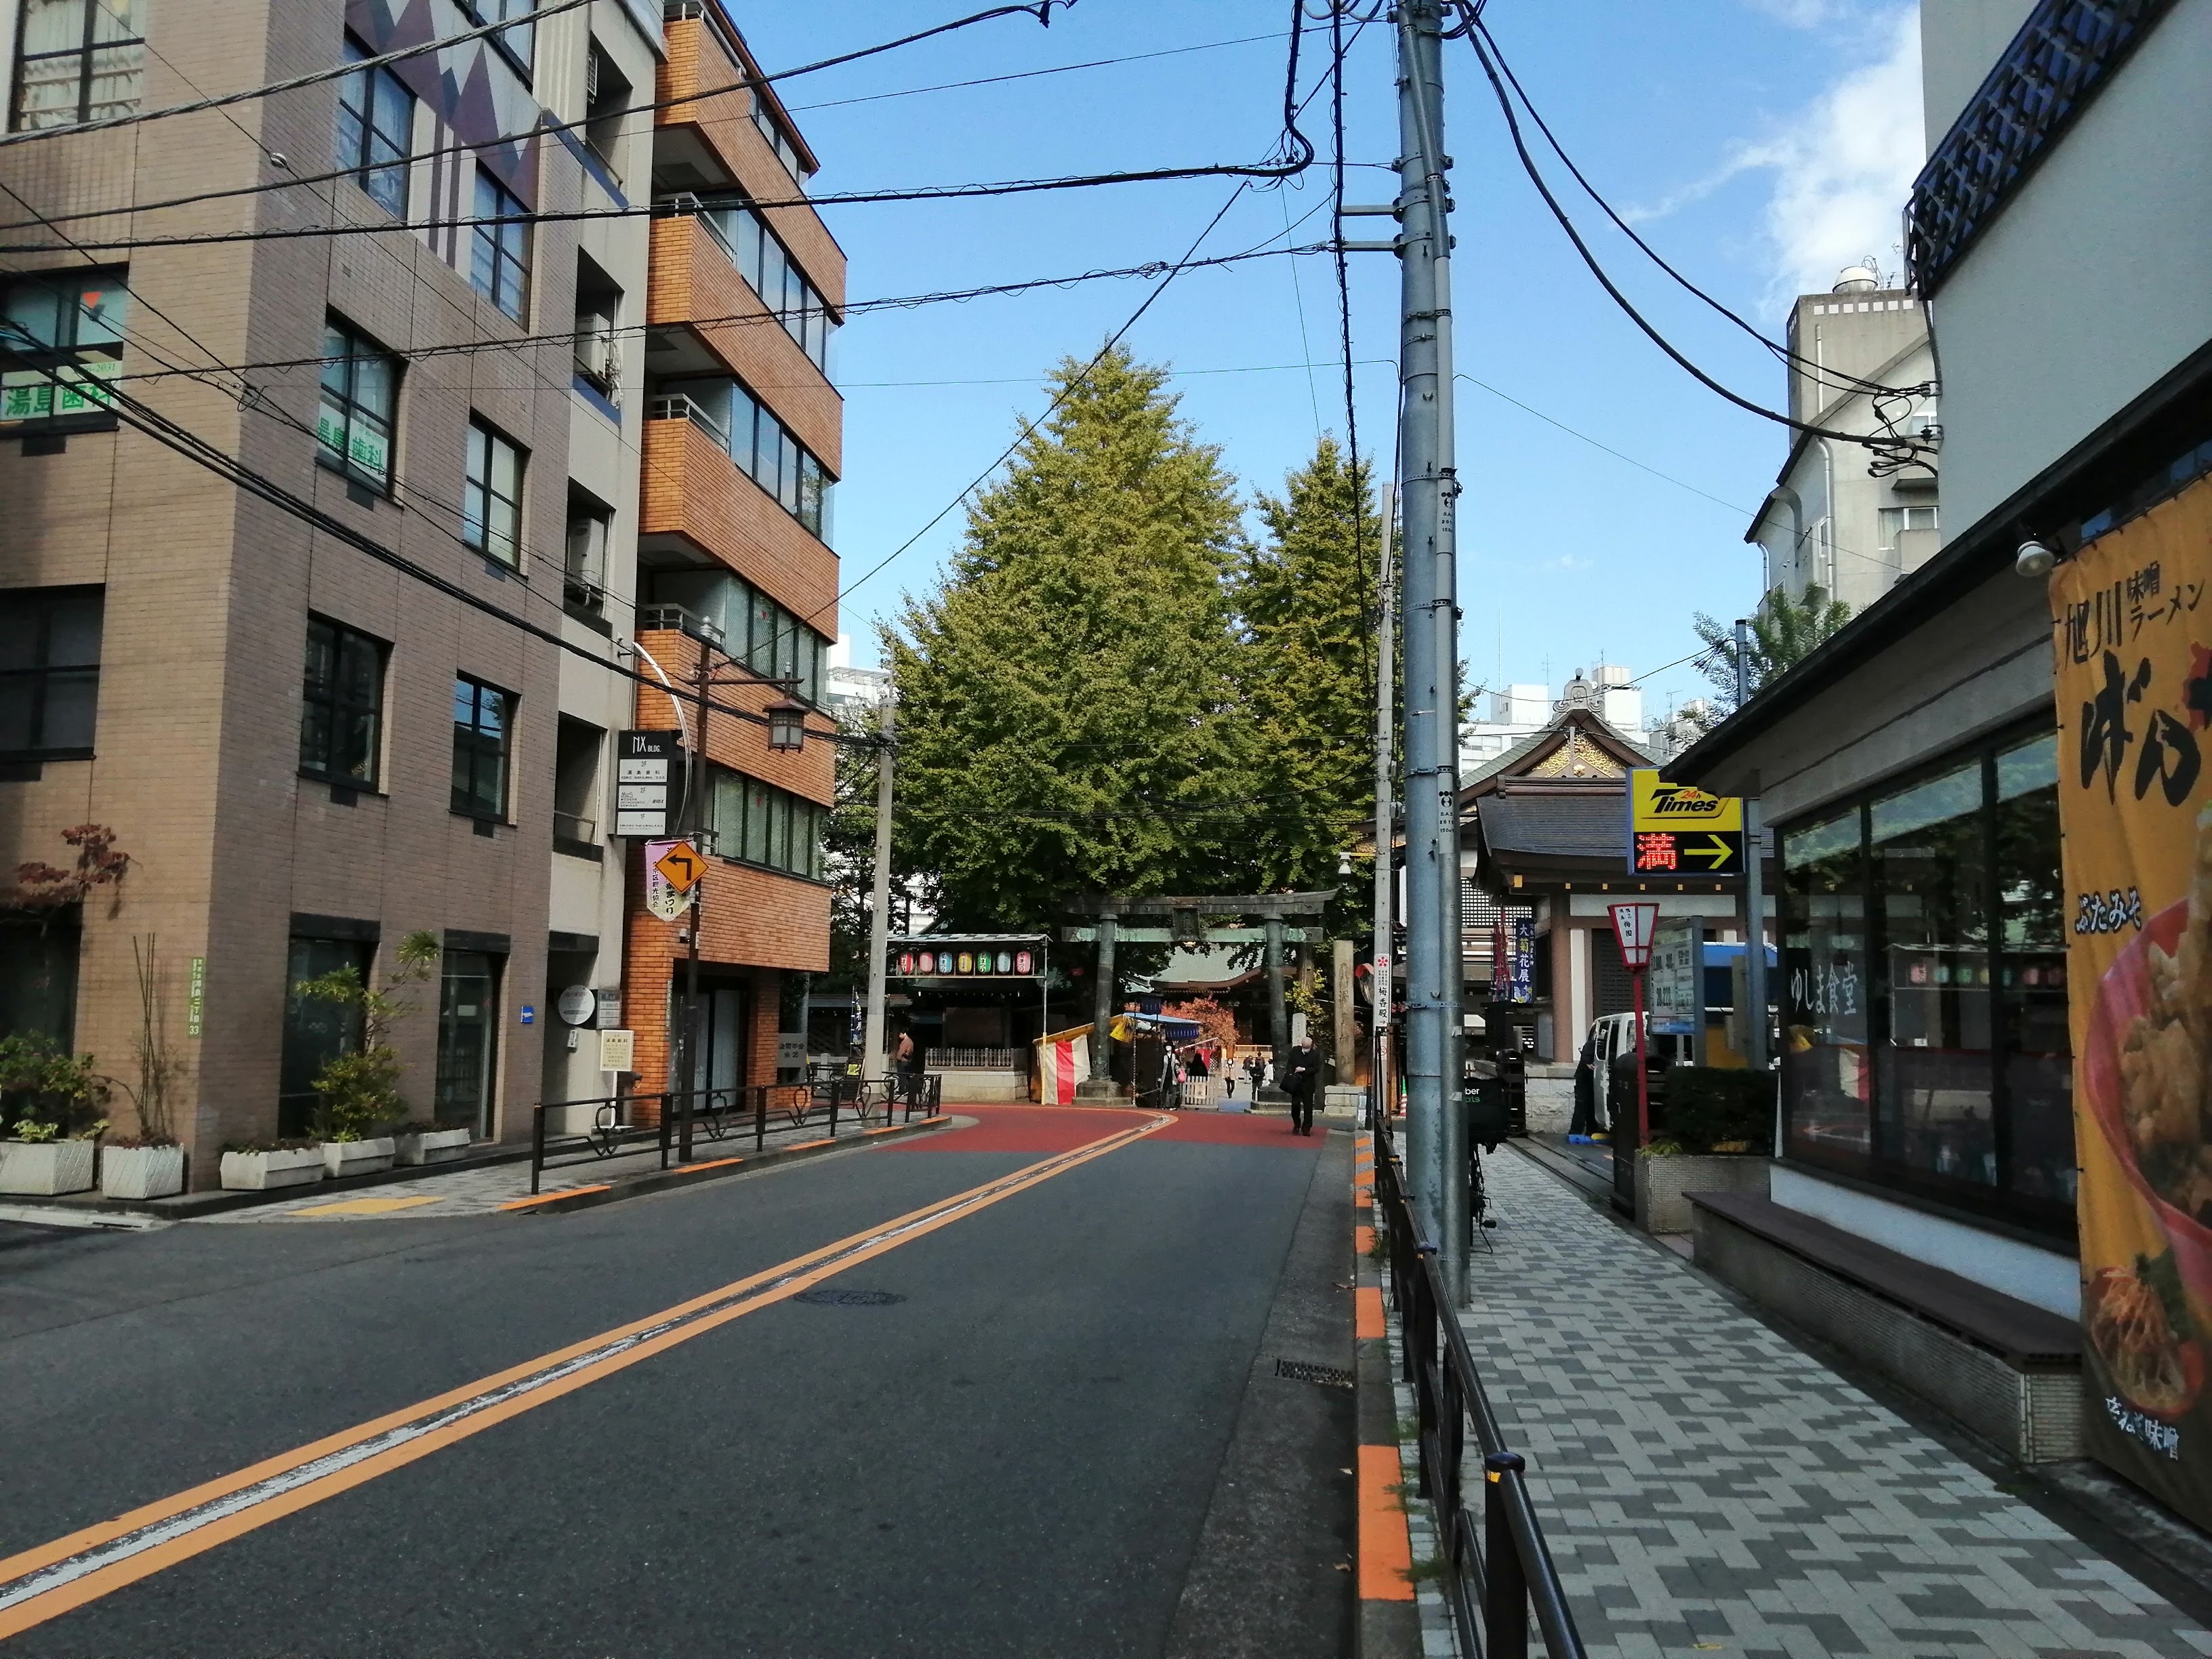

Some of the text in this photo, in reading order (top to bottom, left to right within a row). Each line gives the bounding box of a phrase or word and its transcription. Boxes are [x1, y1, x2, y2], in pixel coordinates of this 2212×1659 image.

[2065, 560, 2161, 671] 旭川 味噌
[2130, 579, 2205, 642] ラーメン
[1651, 789, 1718, 813] Times
[1680, 790, 1701, 799] 24h
[1637, 833, 1677, 870] 満
[2074, 885, 2142, 935] ぶたみそ
[1518, 923, 1531, 983] 大菊花展
[1378, 986, 1388, 1019] 梅香殿
[1790, 960, 1858, 1015] ゆしま食堂
[190, 1025, 199, 1034] 33
[1465, 1087, 1480, 1095] ber
